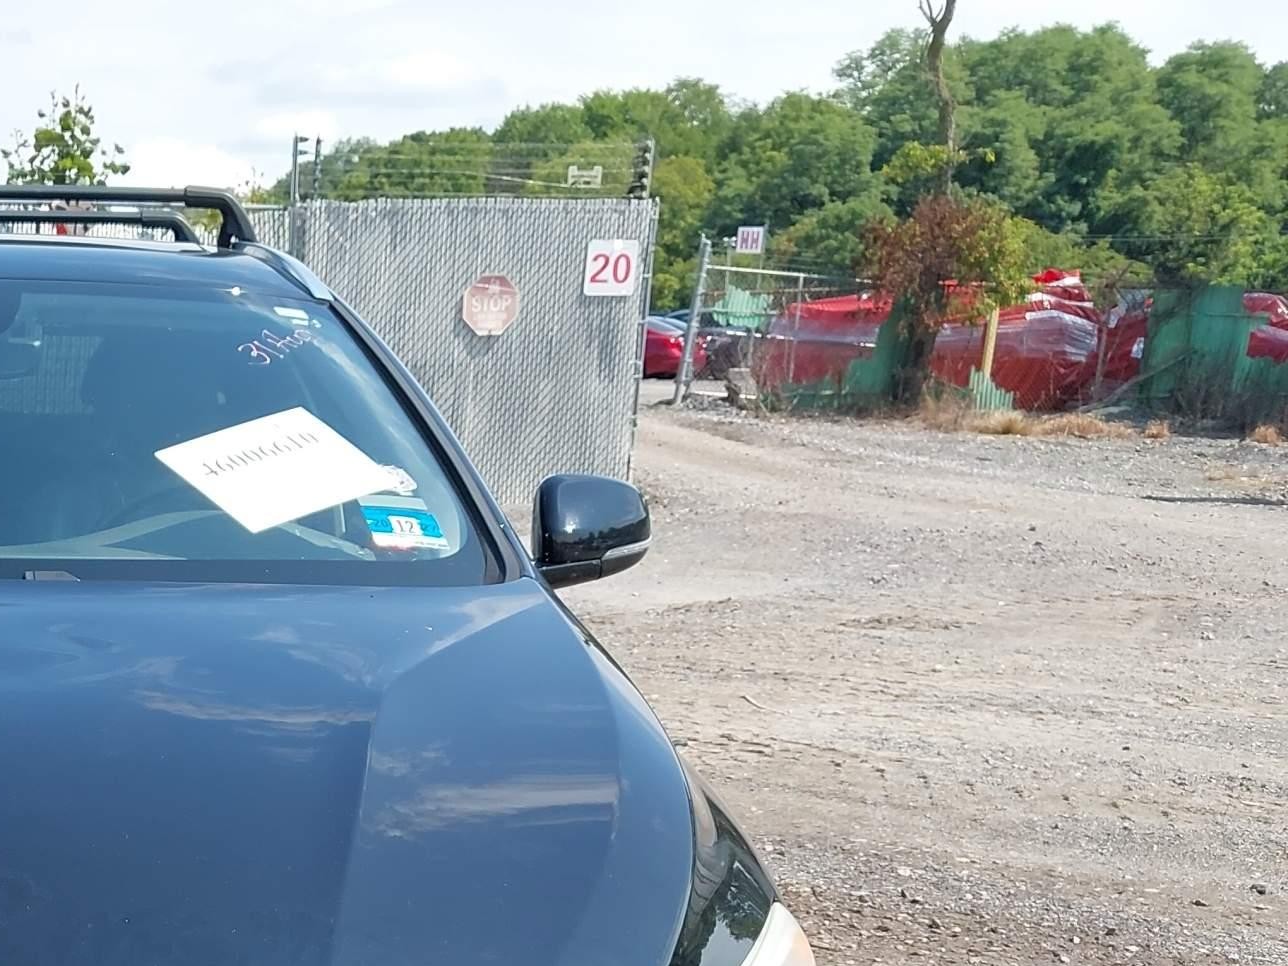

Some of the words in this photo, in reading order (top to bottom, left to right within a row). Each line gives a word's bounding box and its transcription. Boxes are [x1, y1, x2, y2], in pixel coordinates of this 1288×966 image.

[739, 230, 760, 249] HH
[589, 253, 631, 284] 20
[471, 295, 512, 312] STOP
[396, 519, 416, 533] 12
